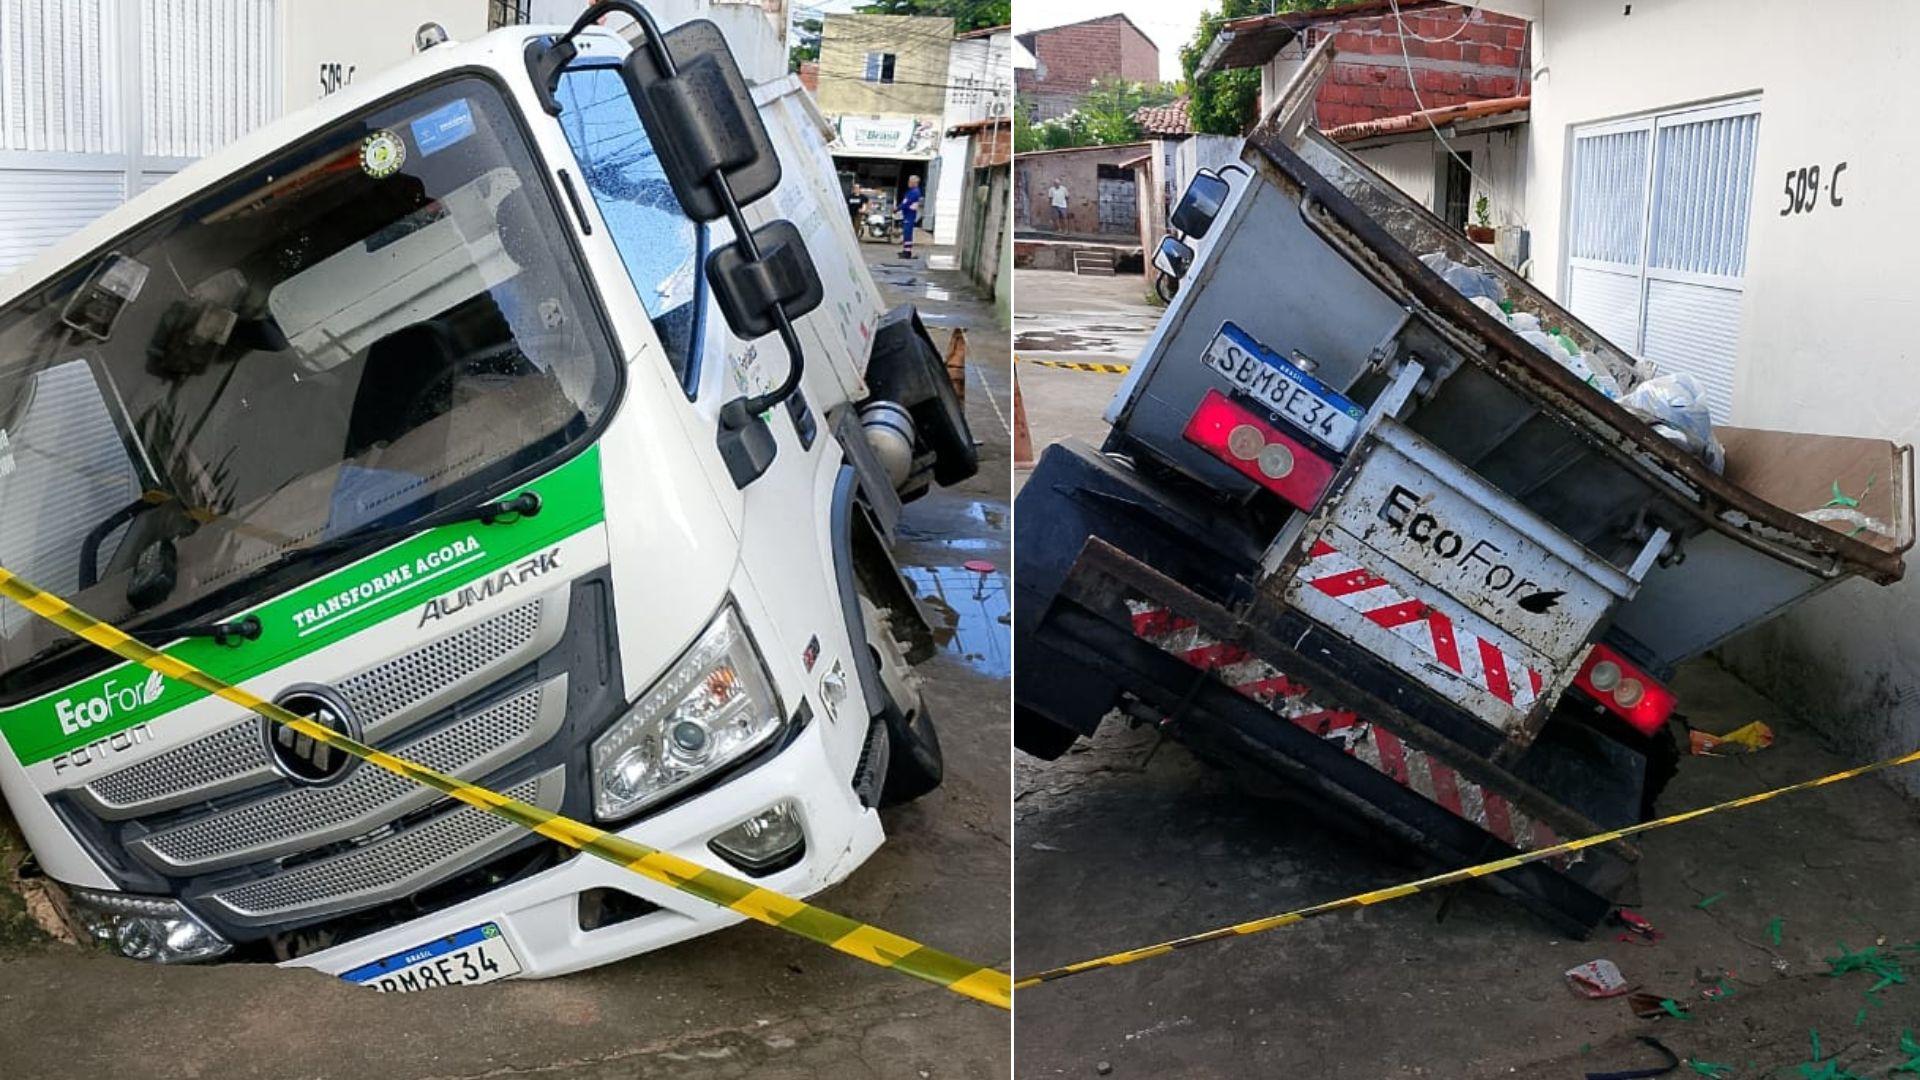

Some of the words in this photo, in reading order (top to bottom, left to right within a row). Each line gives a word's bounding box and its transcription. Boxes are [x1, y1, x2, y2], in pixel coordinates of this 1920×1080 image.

[1219, 346, 1338, 436] SBM8E34
[1280, 364, 1304, 383] BRASIL
[1377, 484, 1539, 599] EcoFor
[291, 564, 413, 629] TRANSFORME
[416, 535, 481, 574] AGORA
[417, 547, 561, 629] AUMARK
[55, 679, 146, 736] EcoFor
[53, 724, 154, 776] FOTON
[367, 946, 499, 993] M8E34
[404, 951, 433, 965] BRASIL
